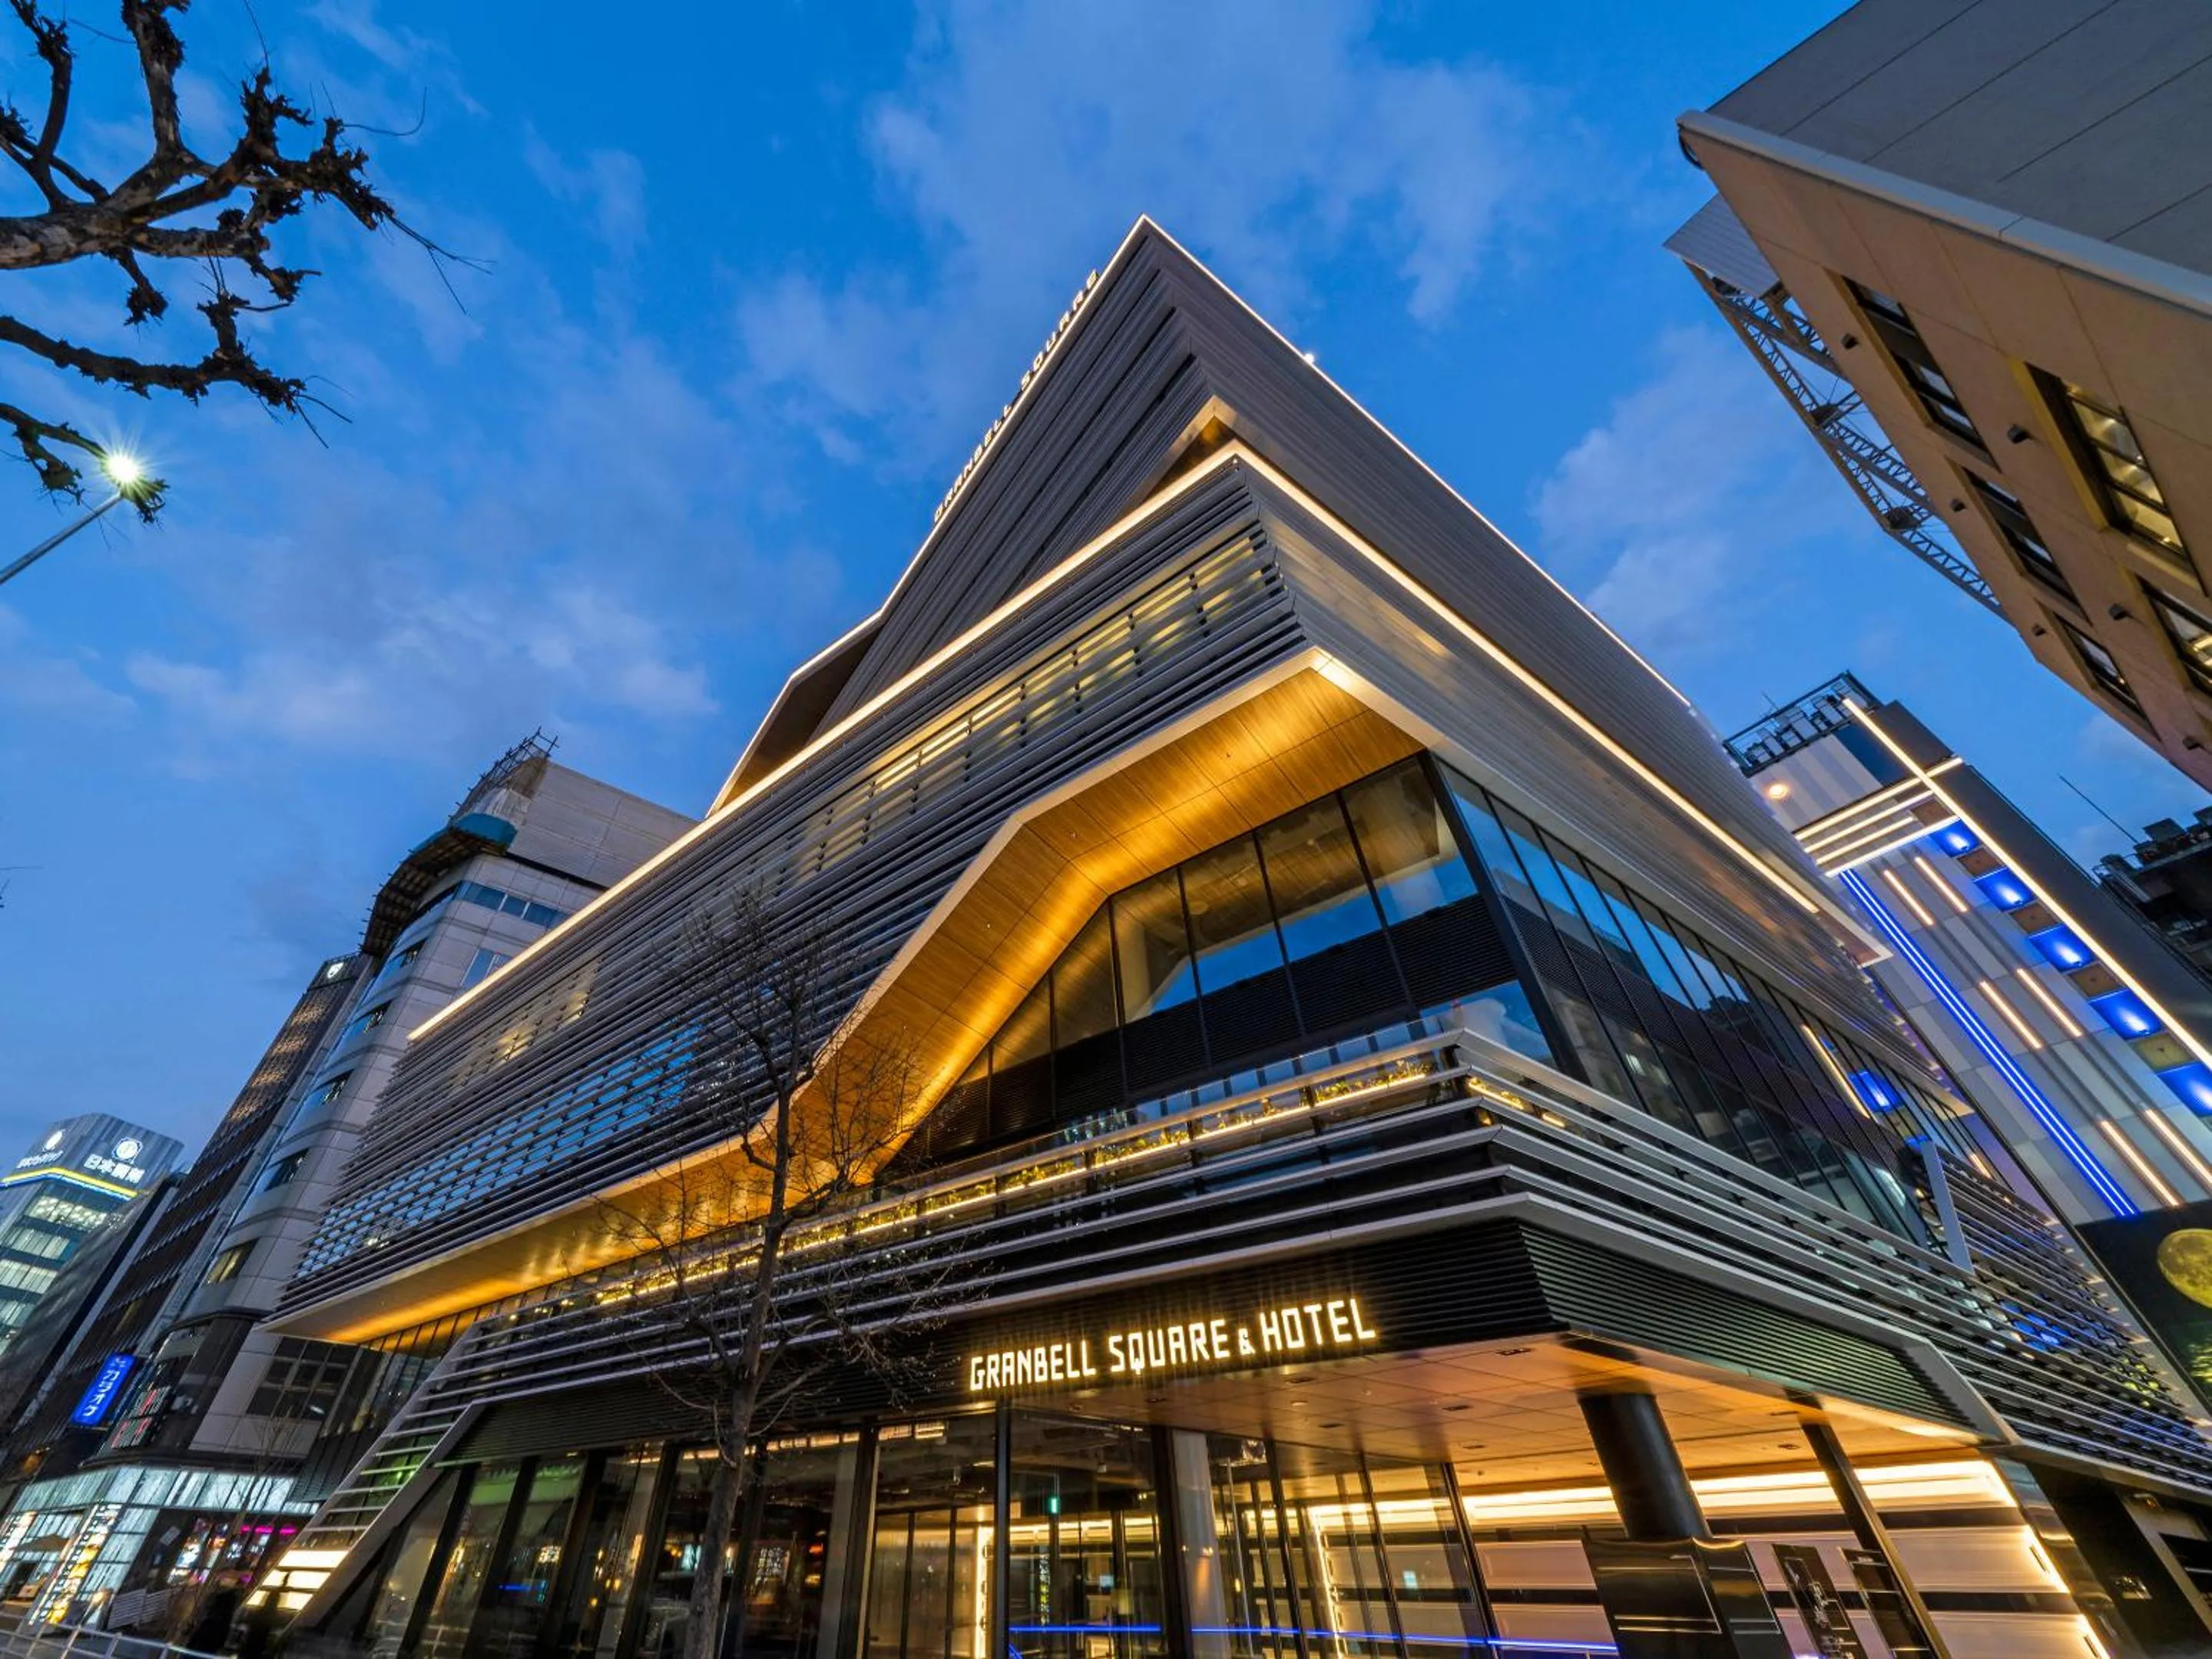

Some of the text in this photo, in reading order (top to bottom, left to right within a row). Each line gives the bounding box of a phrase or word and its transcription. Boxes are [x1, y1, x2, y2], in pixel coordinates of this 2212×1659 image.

[969, 1298, 1376, 1391] GRANBELL SQUARE & HOTEL
